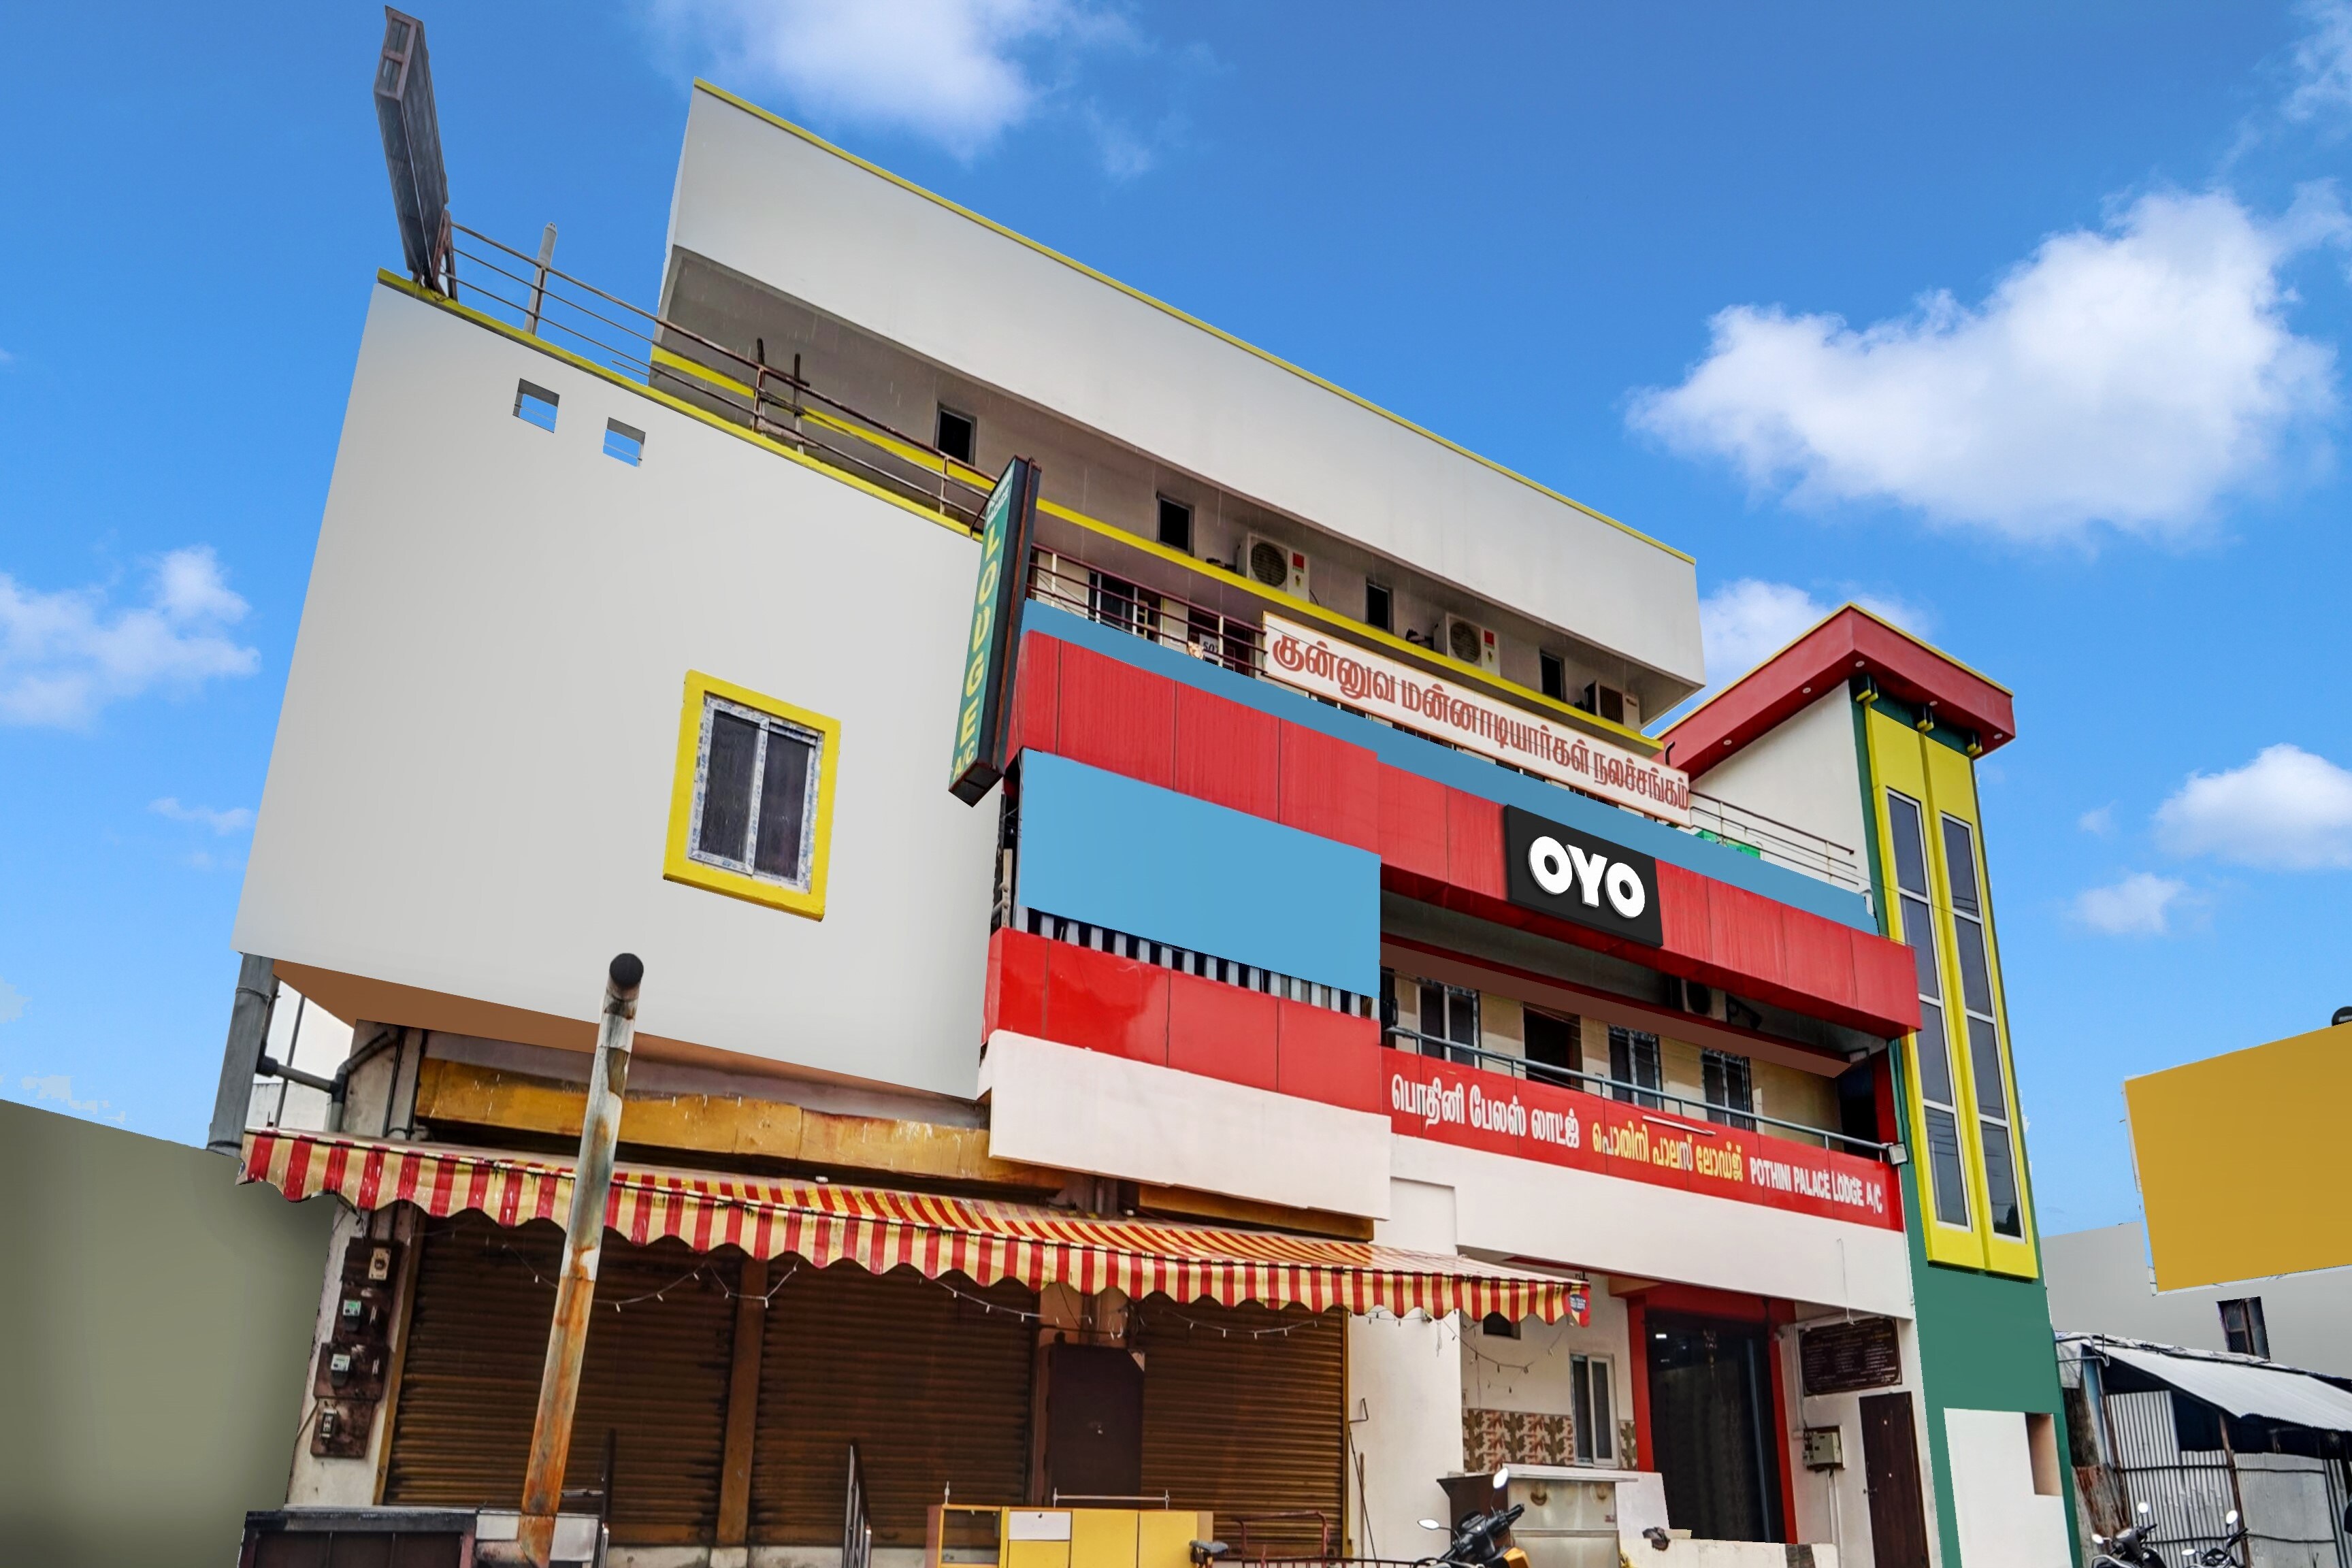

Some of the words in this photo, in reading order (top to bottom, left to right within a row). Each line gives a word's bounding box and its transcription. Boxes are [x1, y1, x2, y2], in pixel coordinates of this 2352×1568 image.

[1273, 634, 1396, 700] குன்னுவ
[1401, 679, 1589, 775] மன்னாடியார்கள்
[953, 740, 975, 781] A/C
[1528, 836, 1646, 919] OYO
[1391, 1073, 1465, 1130] பொதினி
[1469, 1084, 1526, 1137] பேலஸ்
[1750, 1156, 1792, 1192] POTHINI
[1793, 1166, 1831, 1200] PALACE
[1831, 1170, 1864, 1207] LODGE
[1866, 1181, 1883, 1214] A/C
